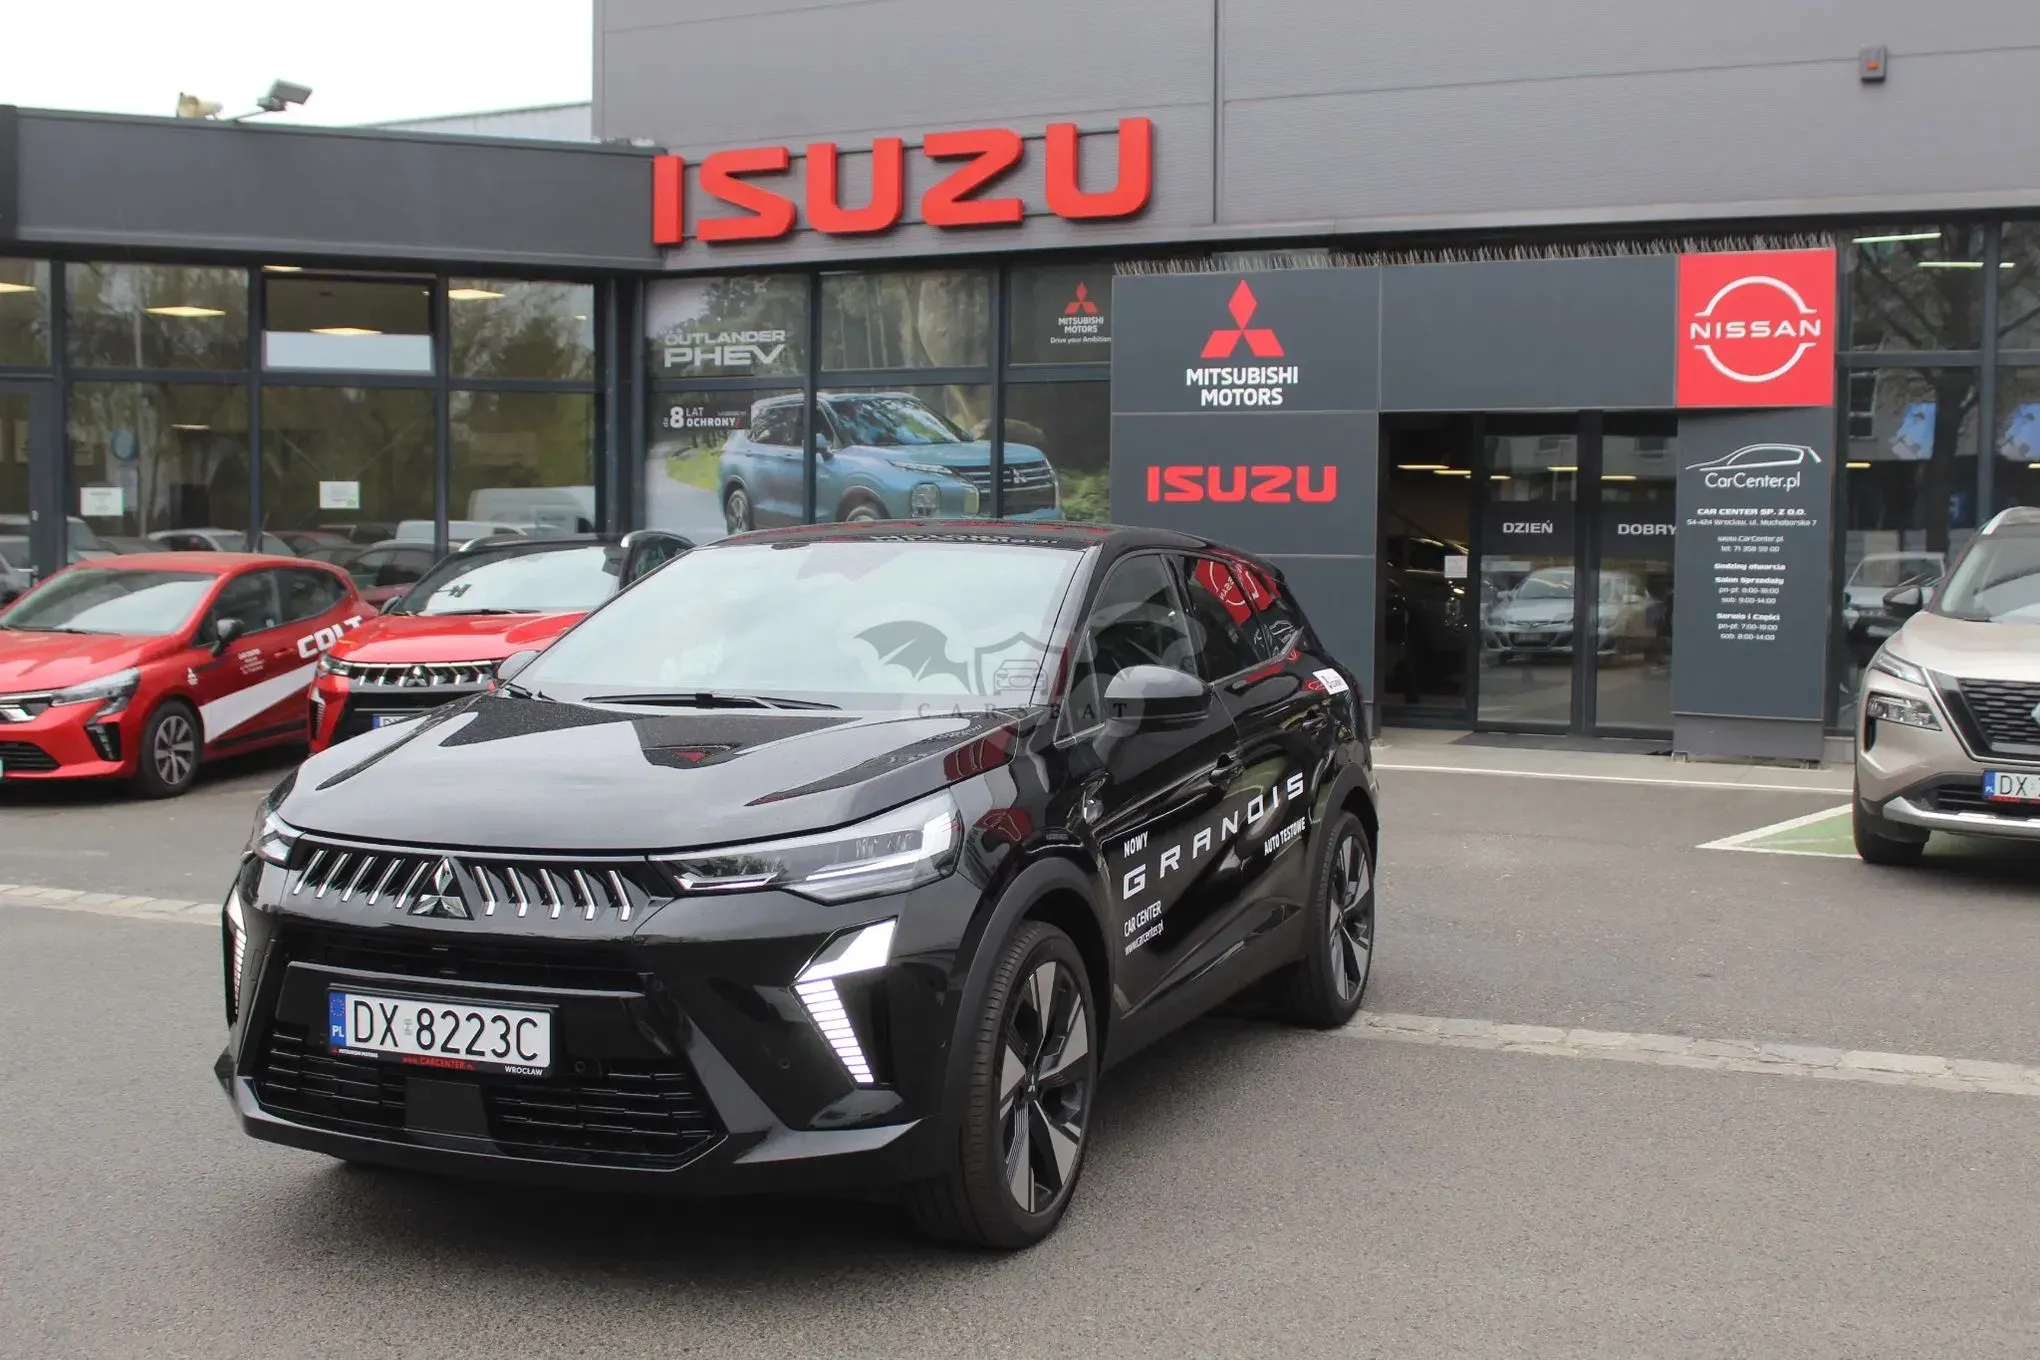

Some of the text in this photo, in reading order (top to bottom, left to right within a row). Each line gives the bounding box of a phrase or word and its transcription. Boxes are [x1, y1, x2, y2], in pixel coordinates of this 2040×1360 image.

[653, 117, 1152, 244] ISUZU
[1058, 316, 1104, 325] MITSUBISHI
[1064, 325, 1098, 333] MOTORS
[1690, 319, 1822, 340] NISSAN
[664, 329, 786, 346] OUTLANDER
[1050, 336, 1067, 344] Drive
[1082, 335, 1112, 343] Ambition
[664, 343, 786, 368] PHEV
[1186, 366, 1299, 387] MITSUBISHI
[1200, 387, 1284, 407] MOTORS
[670, 406, 685, 428] 8
[685, 407, 704, 417] LAT
[686, 417, 736, 428] OCHRONY
[1147, 466, 1338, 503] ISUZU
[1704, 471, 1800, 492] CarCenter.pl
[1696, 508, 1717, 516] CAR
[1718, 508, 1758, 516] CENTER
[1760, 508, 1777, 516] SP.
[1502, 519, 1553, 534] DZIEŃ
[1617, 523, 1677, 535] DOBRY
[1713, 563, 1786, 571] Godziny otwarcia
[2000, 775, 2028, 796] DX
[1123, 771, 1304, 900] GRANDIS
[1124, 830, 1149, 858] NOWY
[1264, 816, 1306, 856] AUTO TESTOWE
[1124, 900, 1162, 937] CAR CENTER
[331, 1000, 538, 1061] PL DX 8223C
[504, 1064, 544, 1077] WROCŁAW
